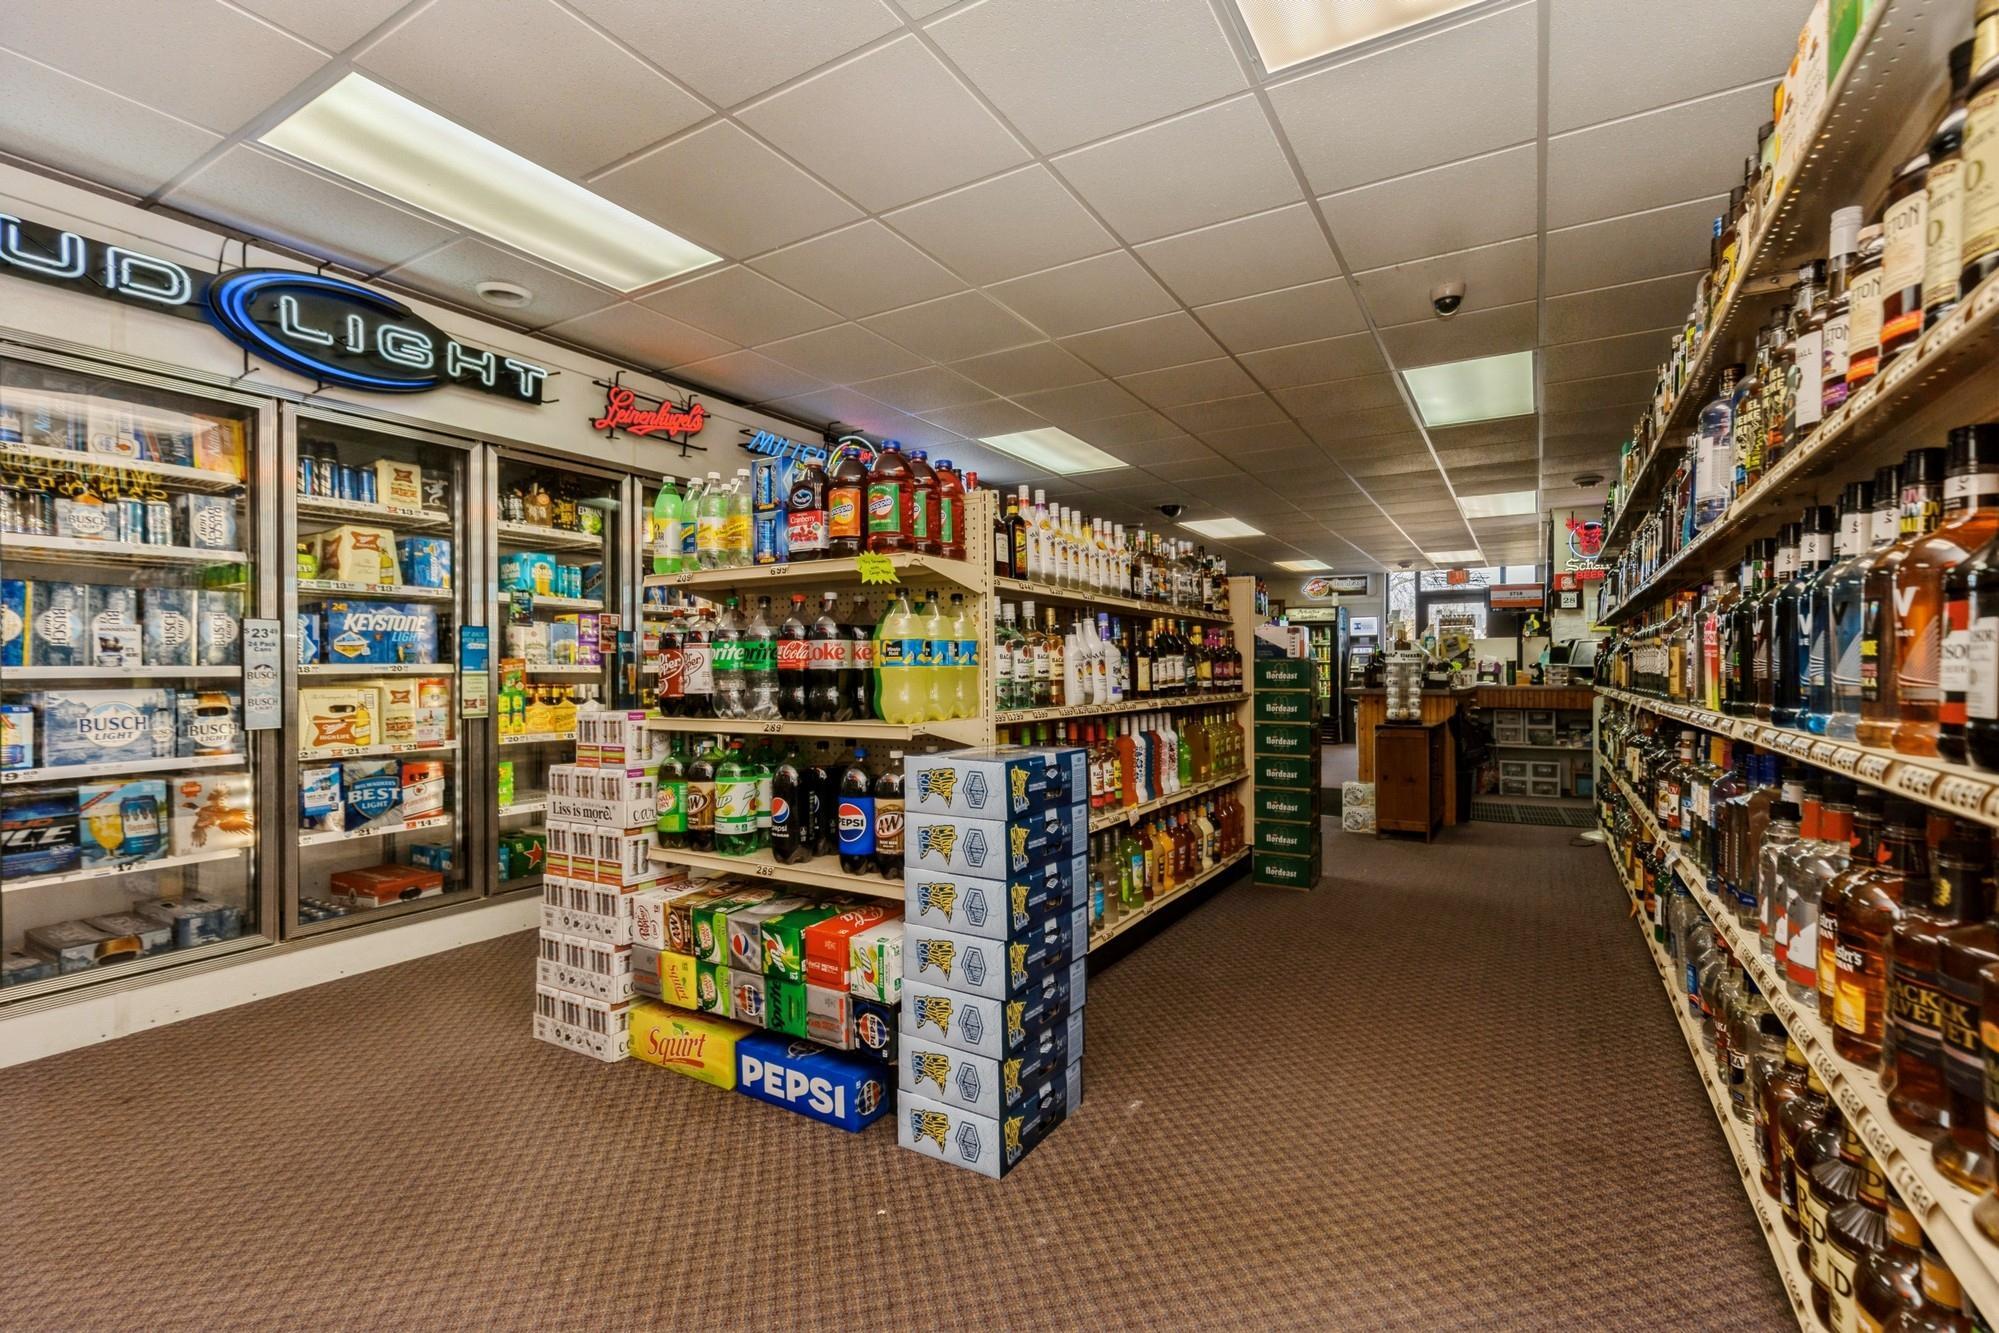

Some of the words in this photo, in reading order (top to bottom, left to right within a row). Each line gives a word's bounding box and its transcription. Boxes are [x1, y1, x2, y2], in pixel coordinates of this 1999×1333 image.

[279, 295, 548, 400] LIGHT
[594, 385, 705, 437] Leinenkugel's
[68, 512, 109, 525] BUSCH
[790, 515, 816, 523] Cranberry
[1577, 571, 1605, 580] BEER
[52, 605, 67, 647] BUSCH
[163, 611, 177, 647] BUSCH
[343, 612, 428, 633] KEYSTONE
[213, 612, 226, 649] BUSCH
[391, 632, 423, 642] LIGHT
[247, 671, 278, 681] BUSCH
[1266, 670, 1297, 682] Nordeast
[247, 697, 279, 708] BUSCH
[1266, 703, 1297, 714] Nordeast
[78, 715, 149, 734] BUSCH
[188, 723, 239, 738] BUSCH
[764, 722, 783, 733] 289
[94, 731, 135, 741] LIGHT
[200, 733, 230, 742] LIGHT
[1266, 736, 1297, 747] Nordeast
[1266, 769, 1297, 780] Nordeast
[920, 773, 930, 798] GOLD
[348, 787, 401, 803] BEST
[361, 800, 388, 810] LIGHT
[552, 801, 571, 816] Liss
[573, 804, 581, 816] is
[1266, 801, 1297, 812] Nordeast
[839, 818, 865, 828] PEPSI
[920, 830, 930, 855] GOLD
[1266, 834, 1297, 845] Nordeast
[756, 865, 774, 876] 289
[1266, 867, 1297, 878] Nordeast
[920, 887, 930, 913] GOLD
[918, 945, 929, 971] GOLD
[669, 964, 689, 1001] Squirt
[769, 979, 784, 1030] Sprite
[916, 1000, 926, 1028] GOLD
[869, 1016, 878, 1046] PEPSI
[647, 1028, 707, 1066] Squirt
[913, 1056, 924, 1084] GOLD
[741, 1054, 846, 1119] PEPSI
[912, 1114, 923, 1143] GOLD
